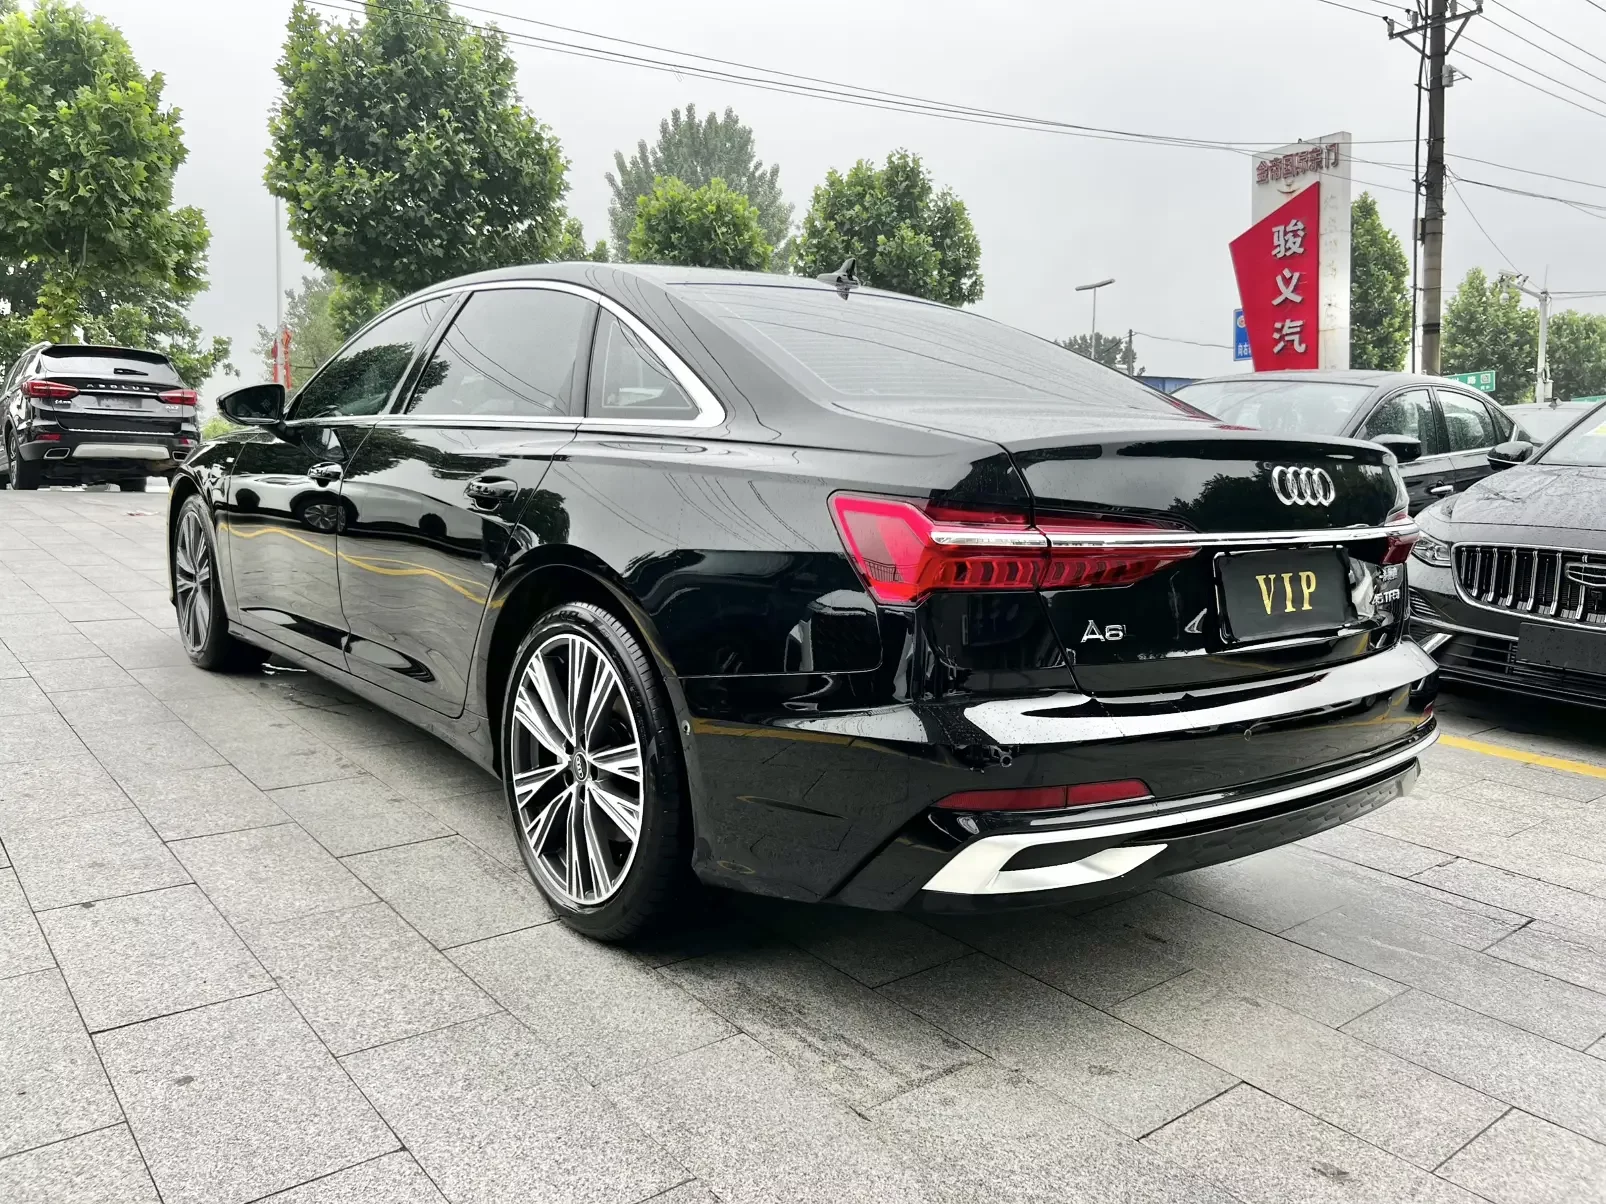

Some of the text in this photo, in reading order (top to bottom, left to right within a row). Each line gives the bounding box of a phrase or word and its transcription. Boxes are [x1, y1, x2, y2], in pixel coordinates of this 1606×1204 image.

[1271, 218, 1306, 354] 骏义汽
[1255, 571, 1317, 615] VIP
